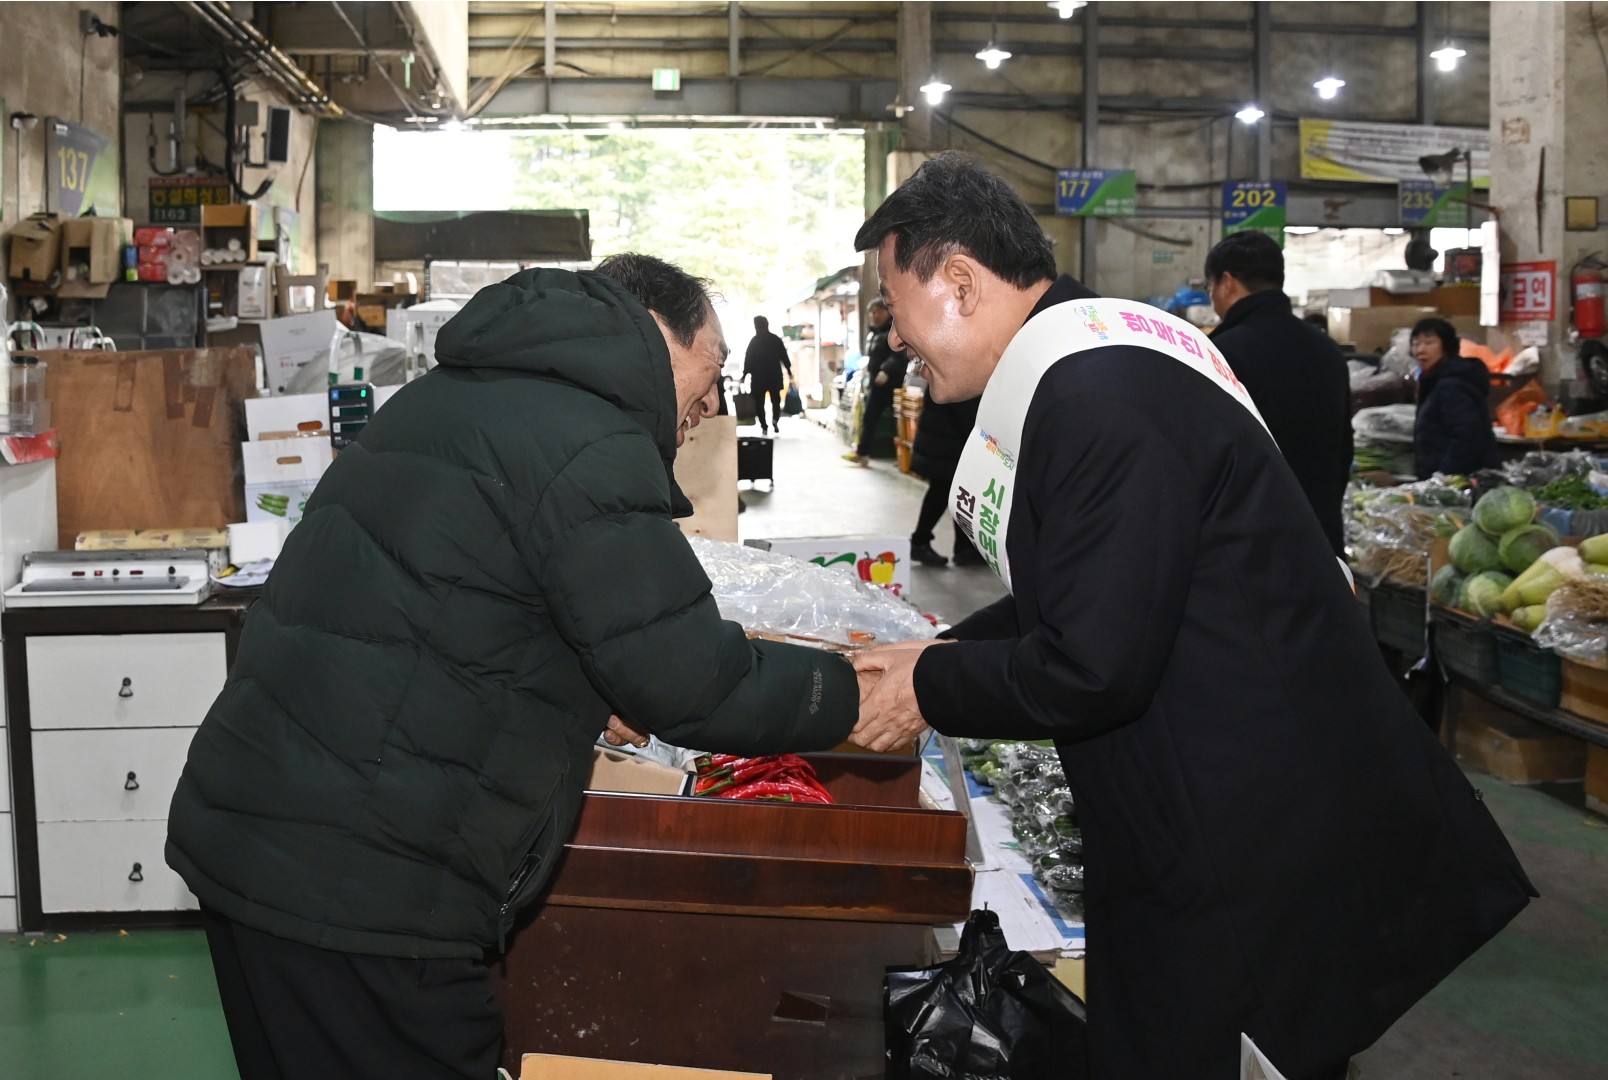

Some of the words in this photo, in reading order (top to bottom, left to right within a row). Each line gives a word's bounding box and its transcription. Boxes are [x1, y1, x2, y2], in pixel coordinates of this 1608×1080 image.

[58, 145, 88, 193] 137
[1060, 180, 1090, 198] 177
[1232, 189, 1276, 207] 202
[1403, 191, 1434, 208] 235
[1512, 277, 1546, 308] 금연
